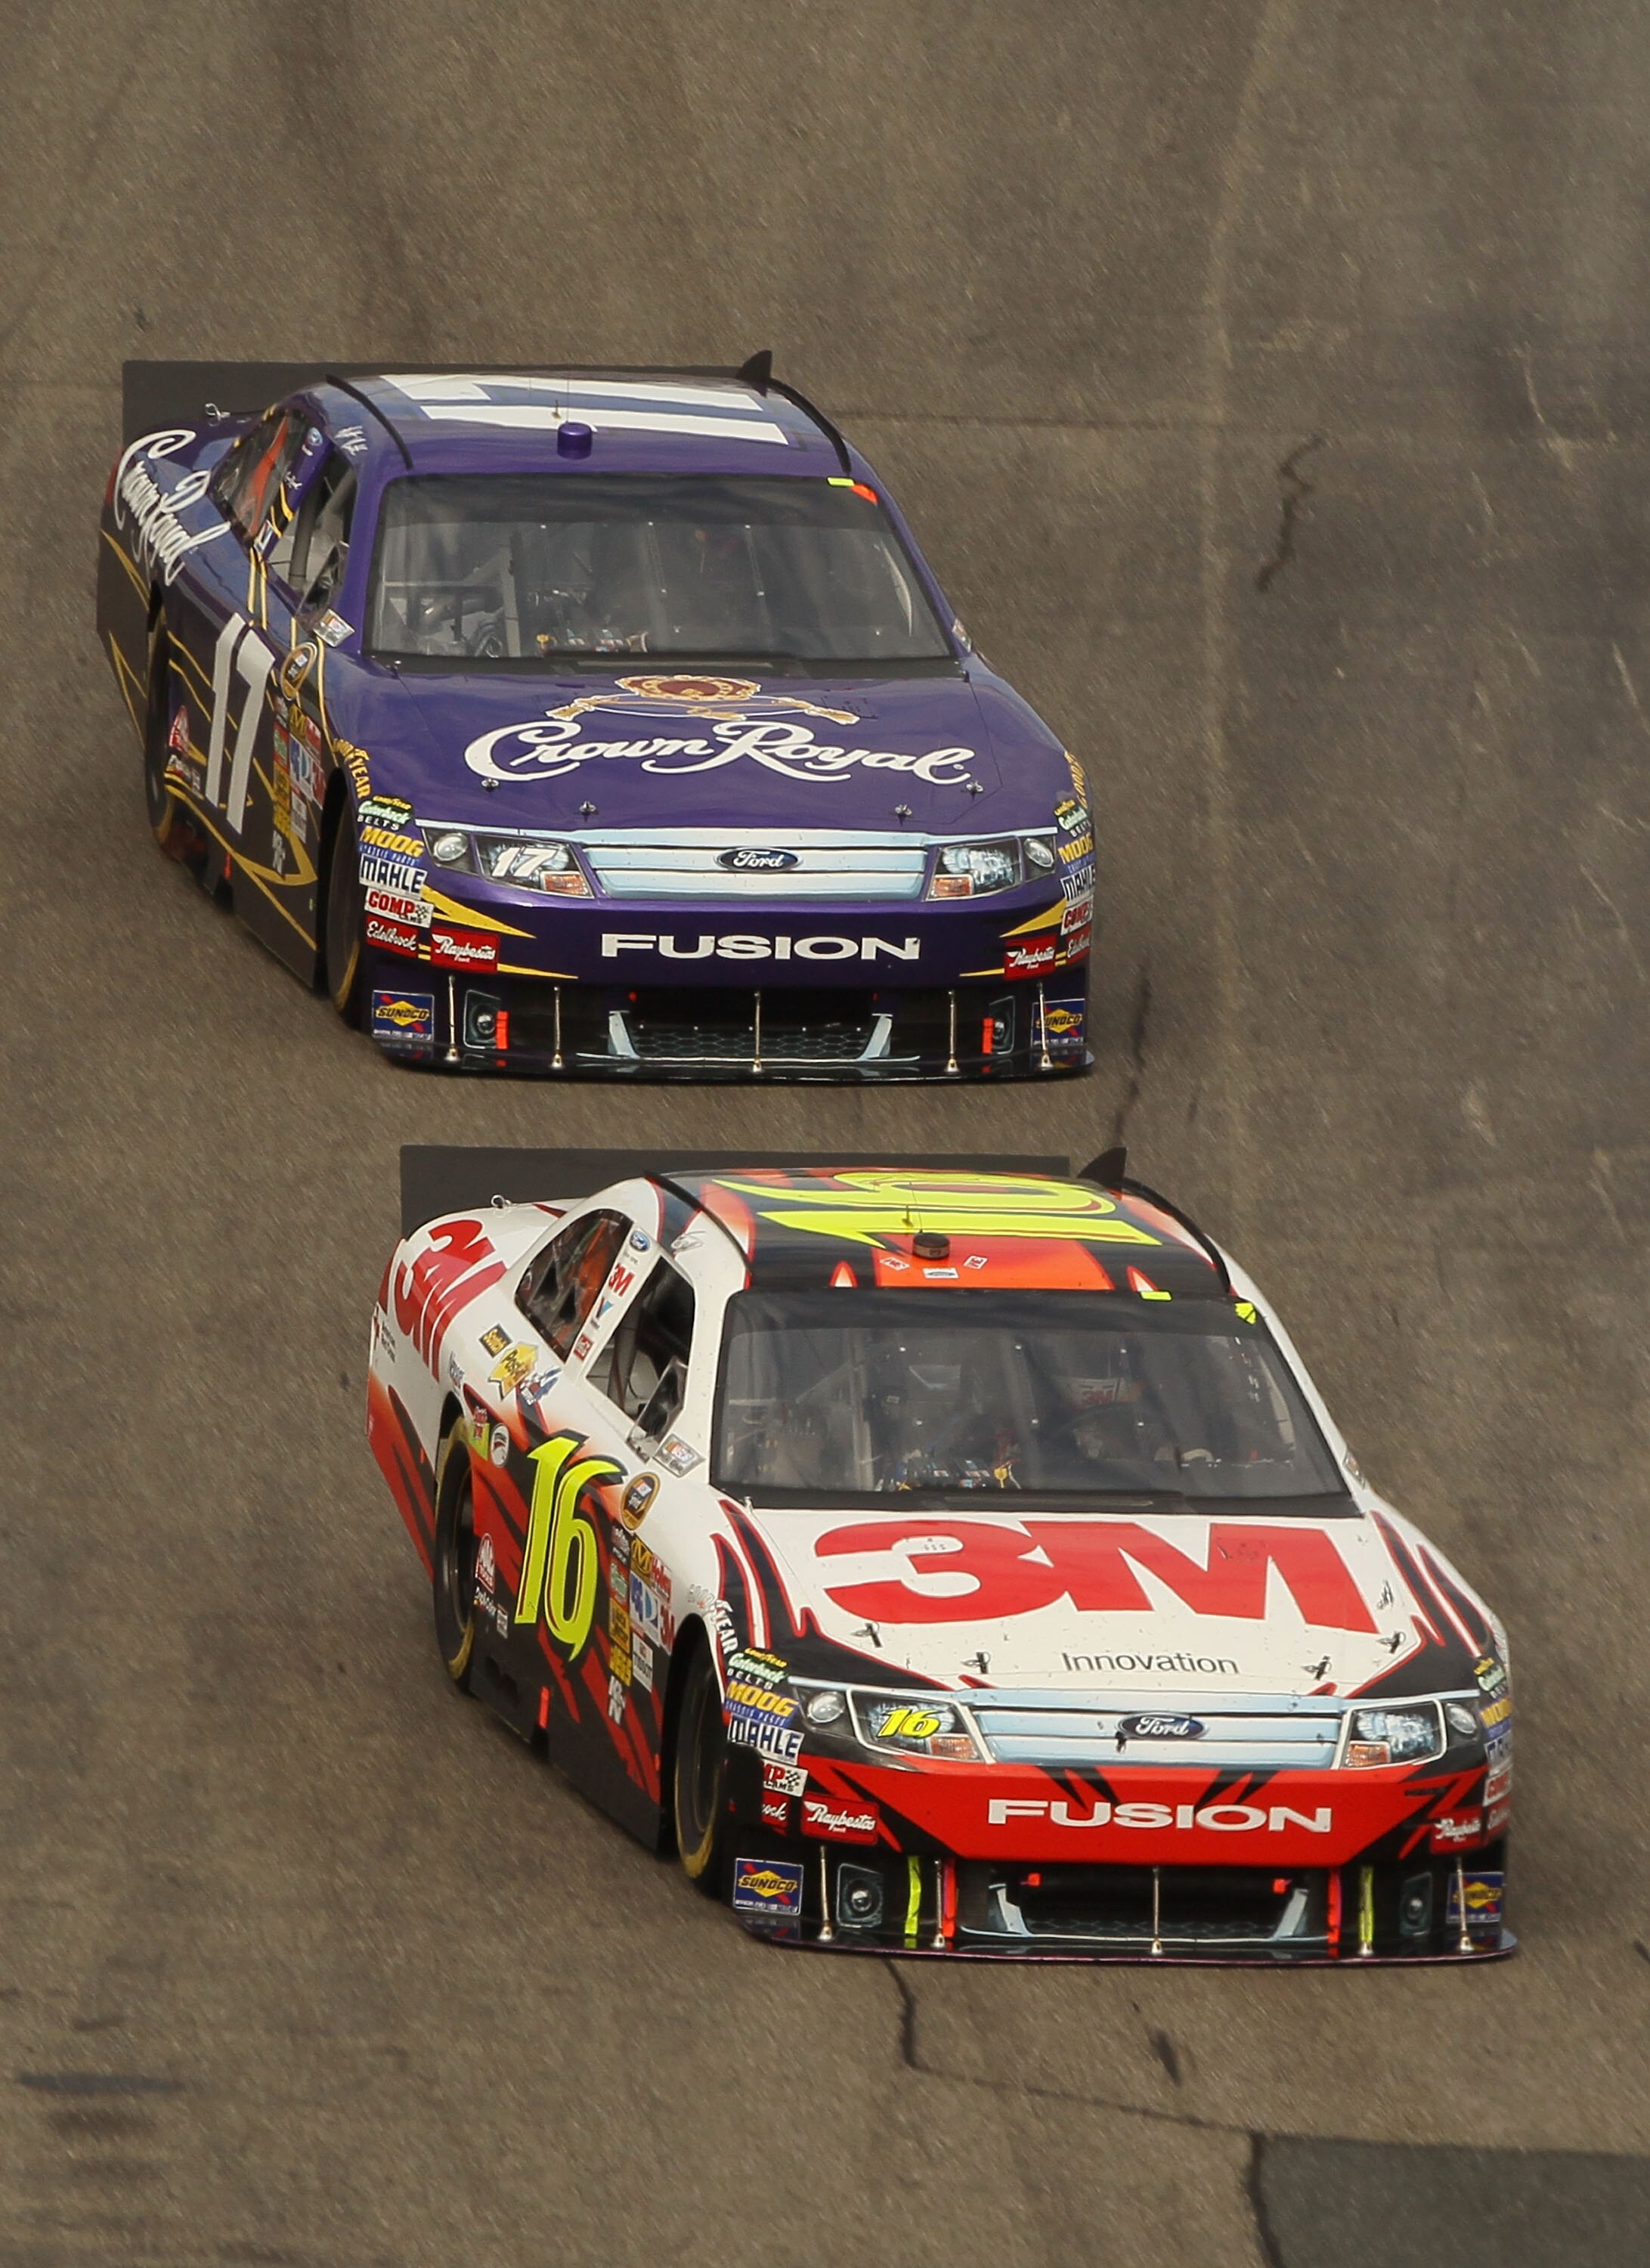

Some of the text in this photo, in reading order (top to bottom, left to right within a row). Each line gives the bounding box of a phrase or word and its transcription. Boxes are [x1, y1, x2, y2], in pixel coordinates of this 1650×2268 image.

[205, 612, 276, 835] 17
[464, 720, 976, 785] Crown Royal
[357, 814, 400, 831] BELTS
[360, 826, 425, 857] MOOG
[1057, 832, 1094, 865] MOOG
[491, 846, 558, 878] 17
[732, 849, 785, 869] Ford
[360, 857, 426, 894] MAHLE
[368, 891, 416, 916] COMP
[366, 920, 418, 951] Edelbrock
[602, 933, 921, 960] FUSION
[377, 1007, 429, 1021] SUNOCO
[608, 1263, 636, 1298] 3M
[514, 1436, 623, 1663] 16
[813, 1520, 1381, 1635] 3M
[1061, 1652, 1240, 1675] Innovation
[726, 1681, 800, 1717] MOOG
[729, 1717, 801, 1758] MAHLE
[876, 1709, 944, 1739] 16
[1135, 1716, 1190, 1736] Ford
[803, 1801, 877, 1830] Raybestos
[988, 1799, 1332, 1833] FUSION
[741, 1876, 795, 1892] SUNOCO
